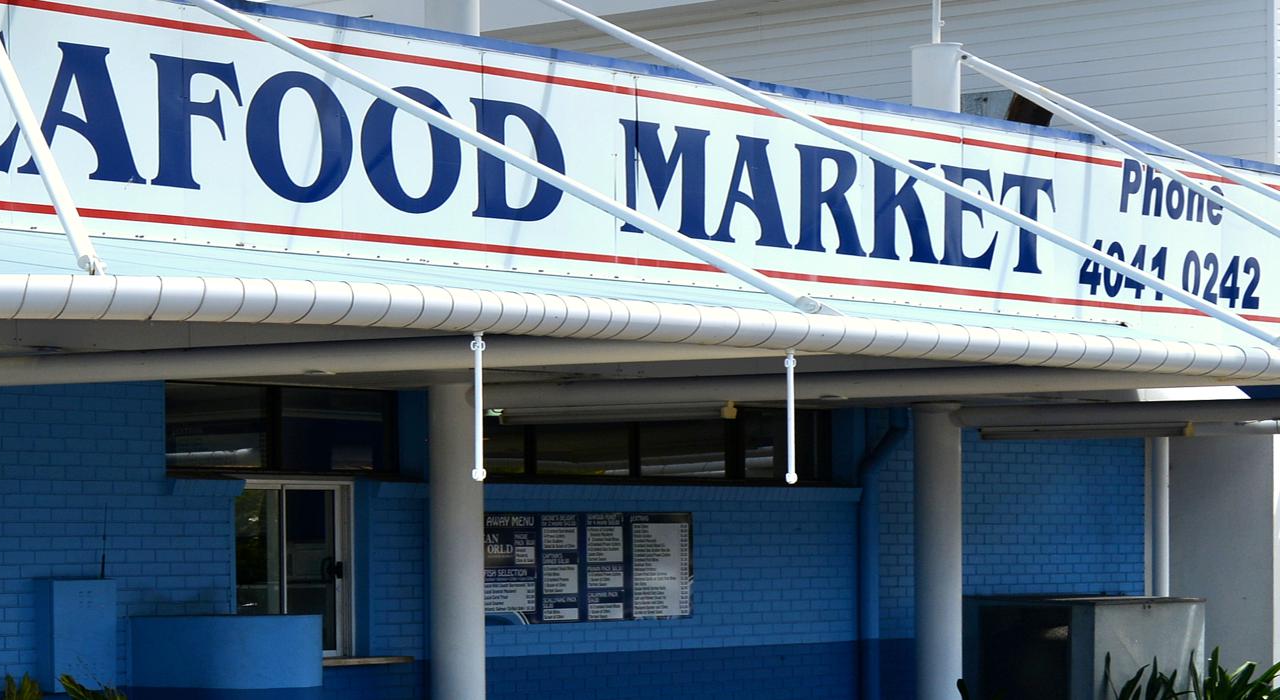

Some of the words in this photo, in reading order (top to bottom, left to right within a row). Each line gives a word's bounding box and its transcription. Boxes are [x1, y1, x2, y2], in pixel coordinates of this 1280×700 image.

[618, 117, 1056, 274] MARKET
[1119, 158, 1225, 226] Phone
[1078, 239, 1168, 302] 4041
[1182, 249, 1261, 309] 0242
[486, 516, 510, 527] AWAY
[511, 515, 535, 526] MENU
[497, 568, 528, 577] SELECTION
